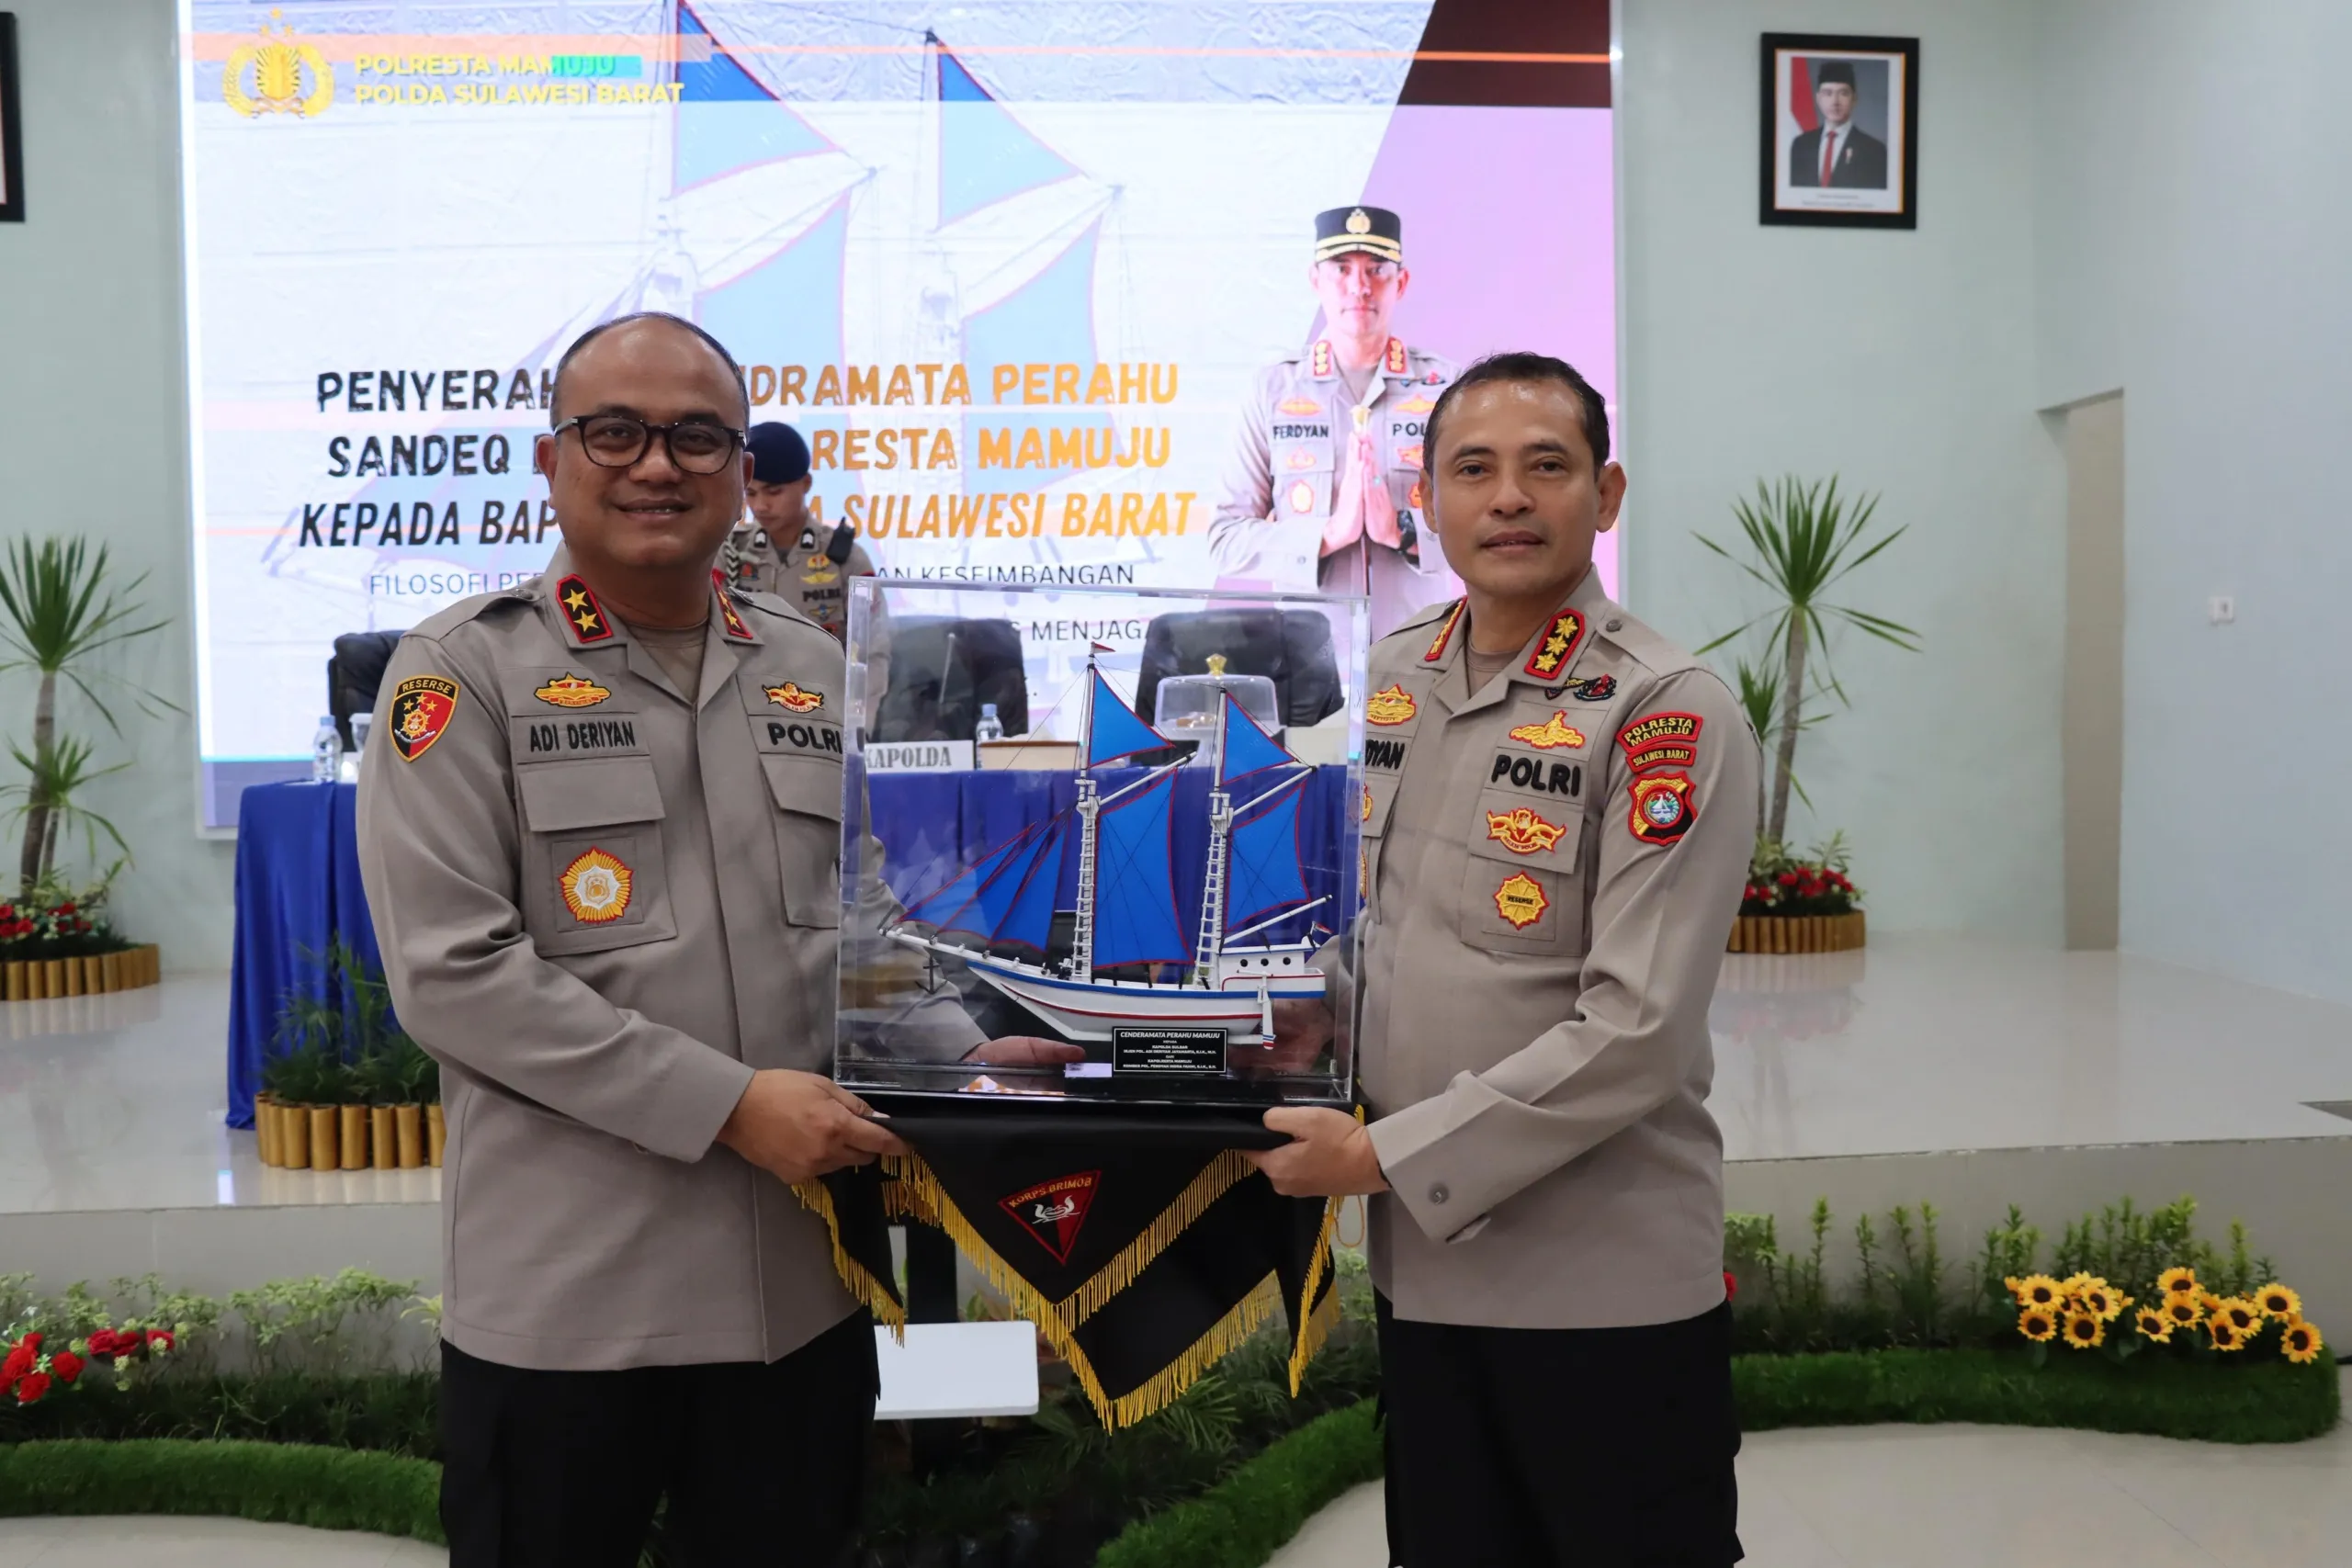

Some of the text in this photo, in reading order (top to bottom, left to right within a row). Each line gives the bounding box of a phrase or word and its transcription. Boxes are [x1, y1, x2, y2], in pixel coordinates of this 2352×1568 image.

[355, 54, 616, 77] POLRESTA MAMUJU
[355, 83, 685, 106] POLDA SULAWESI BARAT
[992, 362, 1179, 405] PERAHU
[1272, 423, 1329, 441] FERDYAN
[328, 434, 510, 478] SANDEQ
[978, 426, 1171, 469] MAMUJU
[300, 501, 459, 547] KEPADA
[843, 492, 1046, 540] SULAWESI
[1060, 491, 1197, 537] BARAT
[370, 572, 489, 596] FILOSOFI
[1033, 618, 1148, 641] MENJAG
[401, 680, 453, 694] RESERSE
[530, 721, 636, 752] ADI DERIYAN
[767, 722, 842, 754] POLRI
[1623, 717, 1692, 742] POLRESTA
[1631, 727, 1689, 747] MAMUJU
[1667, 750, 1690, 761] BARAT
[1491, 754, 1581, 796] POLRI
[1009, 1177, 1092, 1208] KORPS BRIMOB
